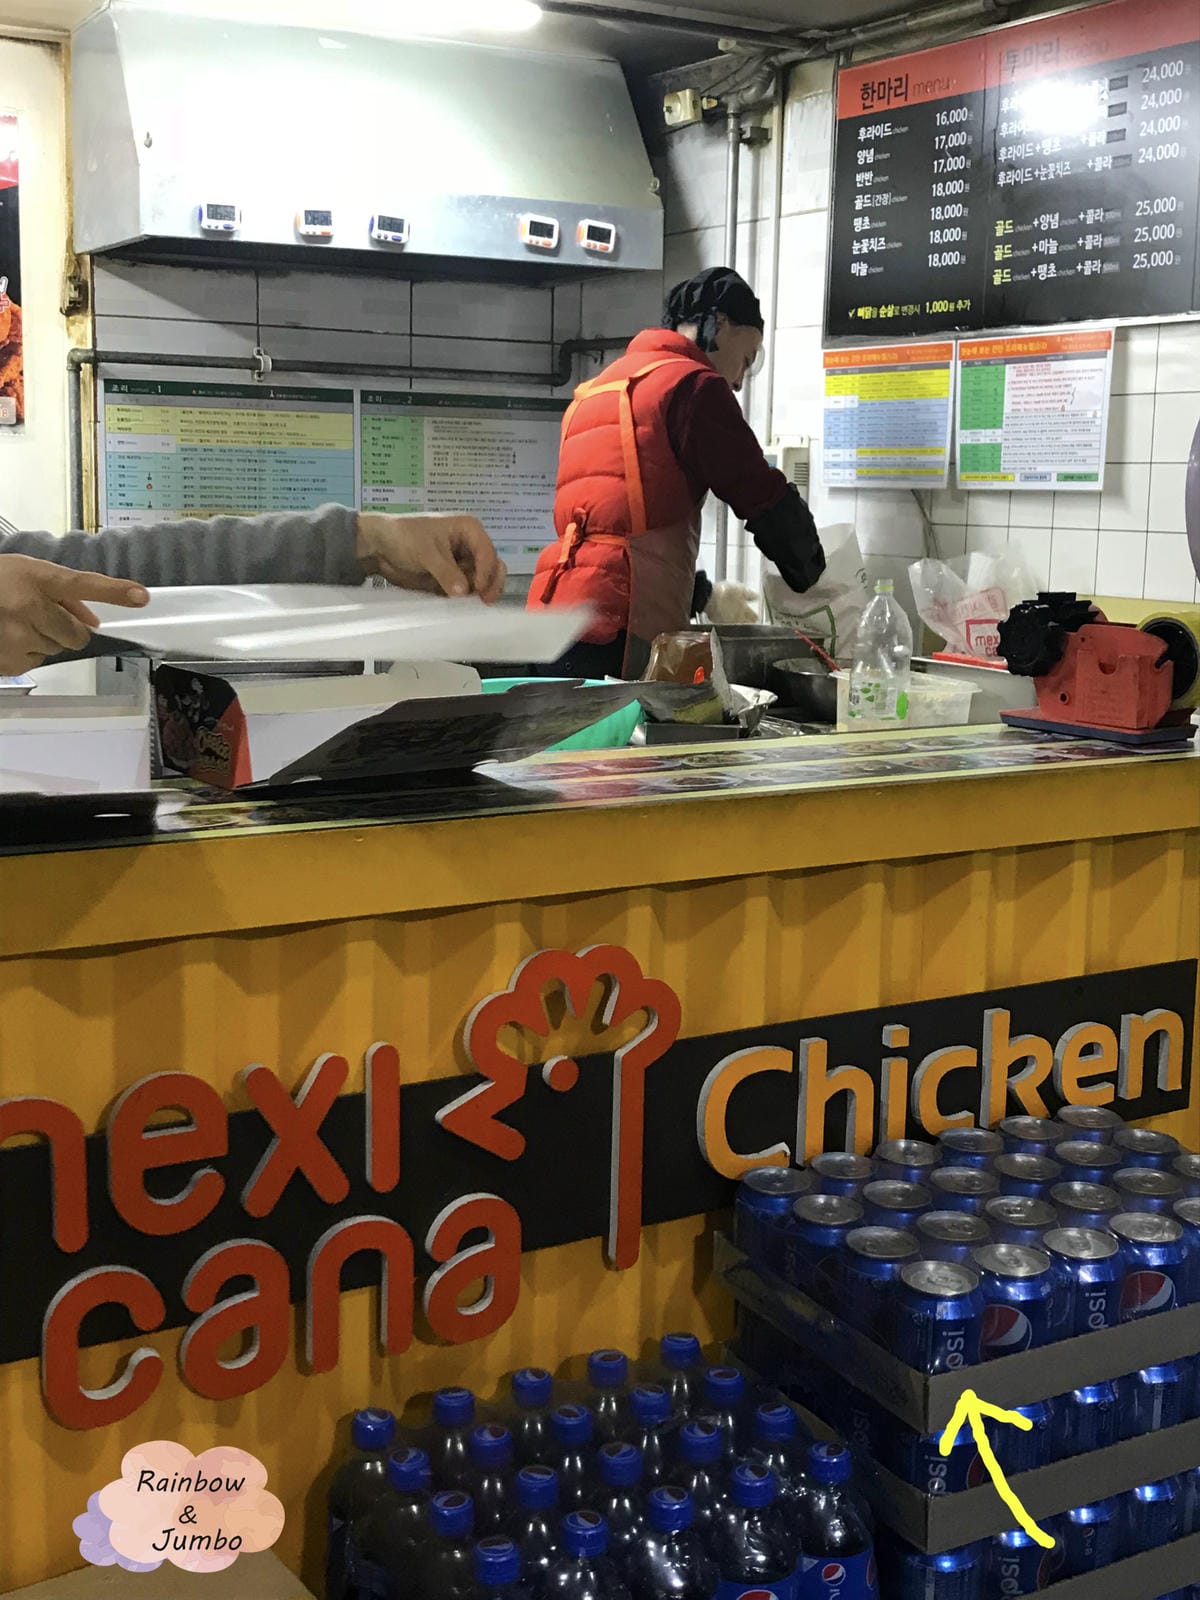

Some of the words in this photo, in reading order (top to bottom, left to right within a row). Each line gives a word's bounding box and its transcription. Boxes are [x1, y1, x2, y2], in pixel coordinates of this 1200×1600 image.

[860, 73, 908, 110] 한마리
[913, 77, 950, 97] menu
[857, 123, 892, 142] 후라이드
[857, 148, 874, 165] 양념
[855, 171, 874, 187] 반반
[997, 168, 1033, 187] 후라이드
[994, 220, 1014, 237] 골드
[993, 244, 1013, 261] 골드
[851, 262, 869, 276] 마늘
[992, 268, 1012, 286] 골드
[697, 1008, 1185, 1180] Chicken
[42, 1192, 522, 1431] cana
